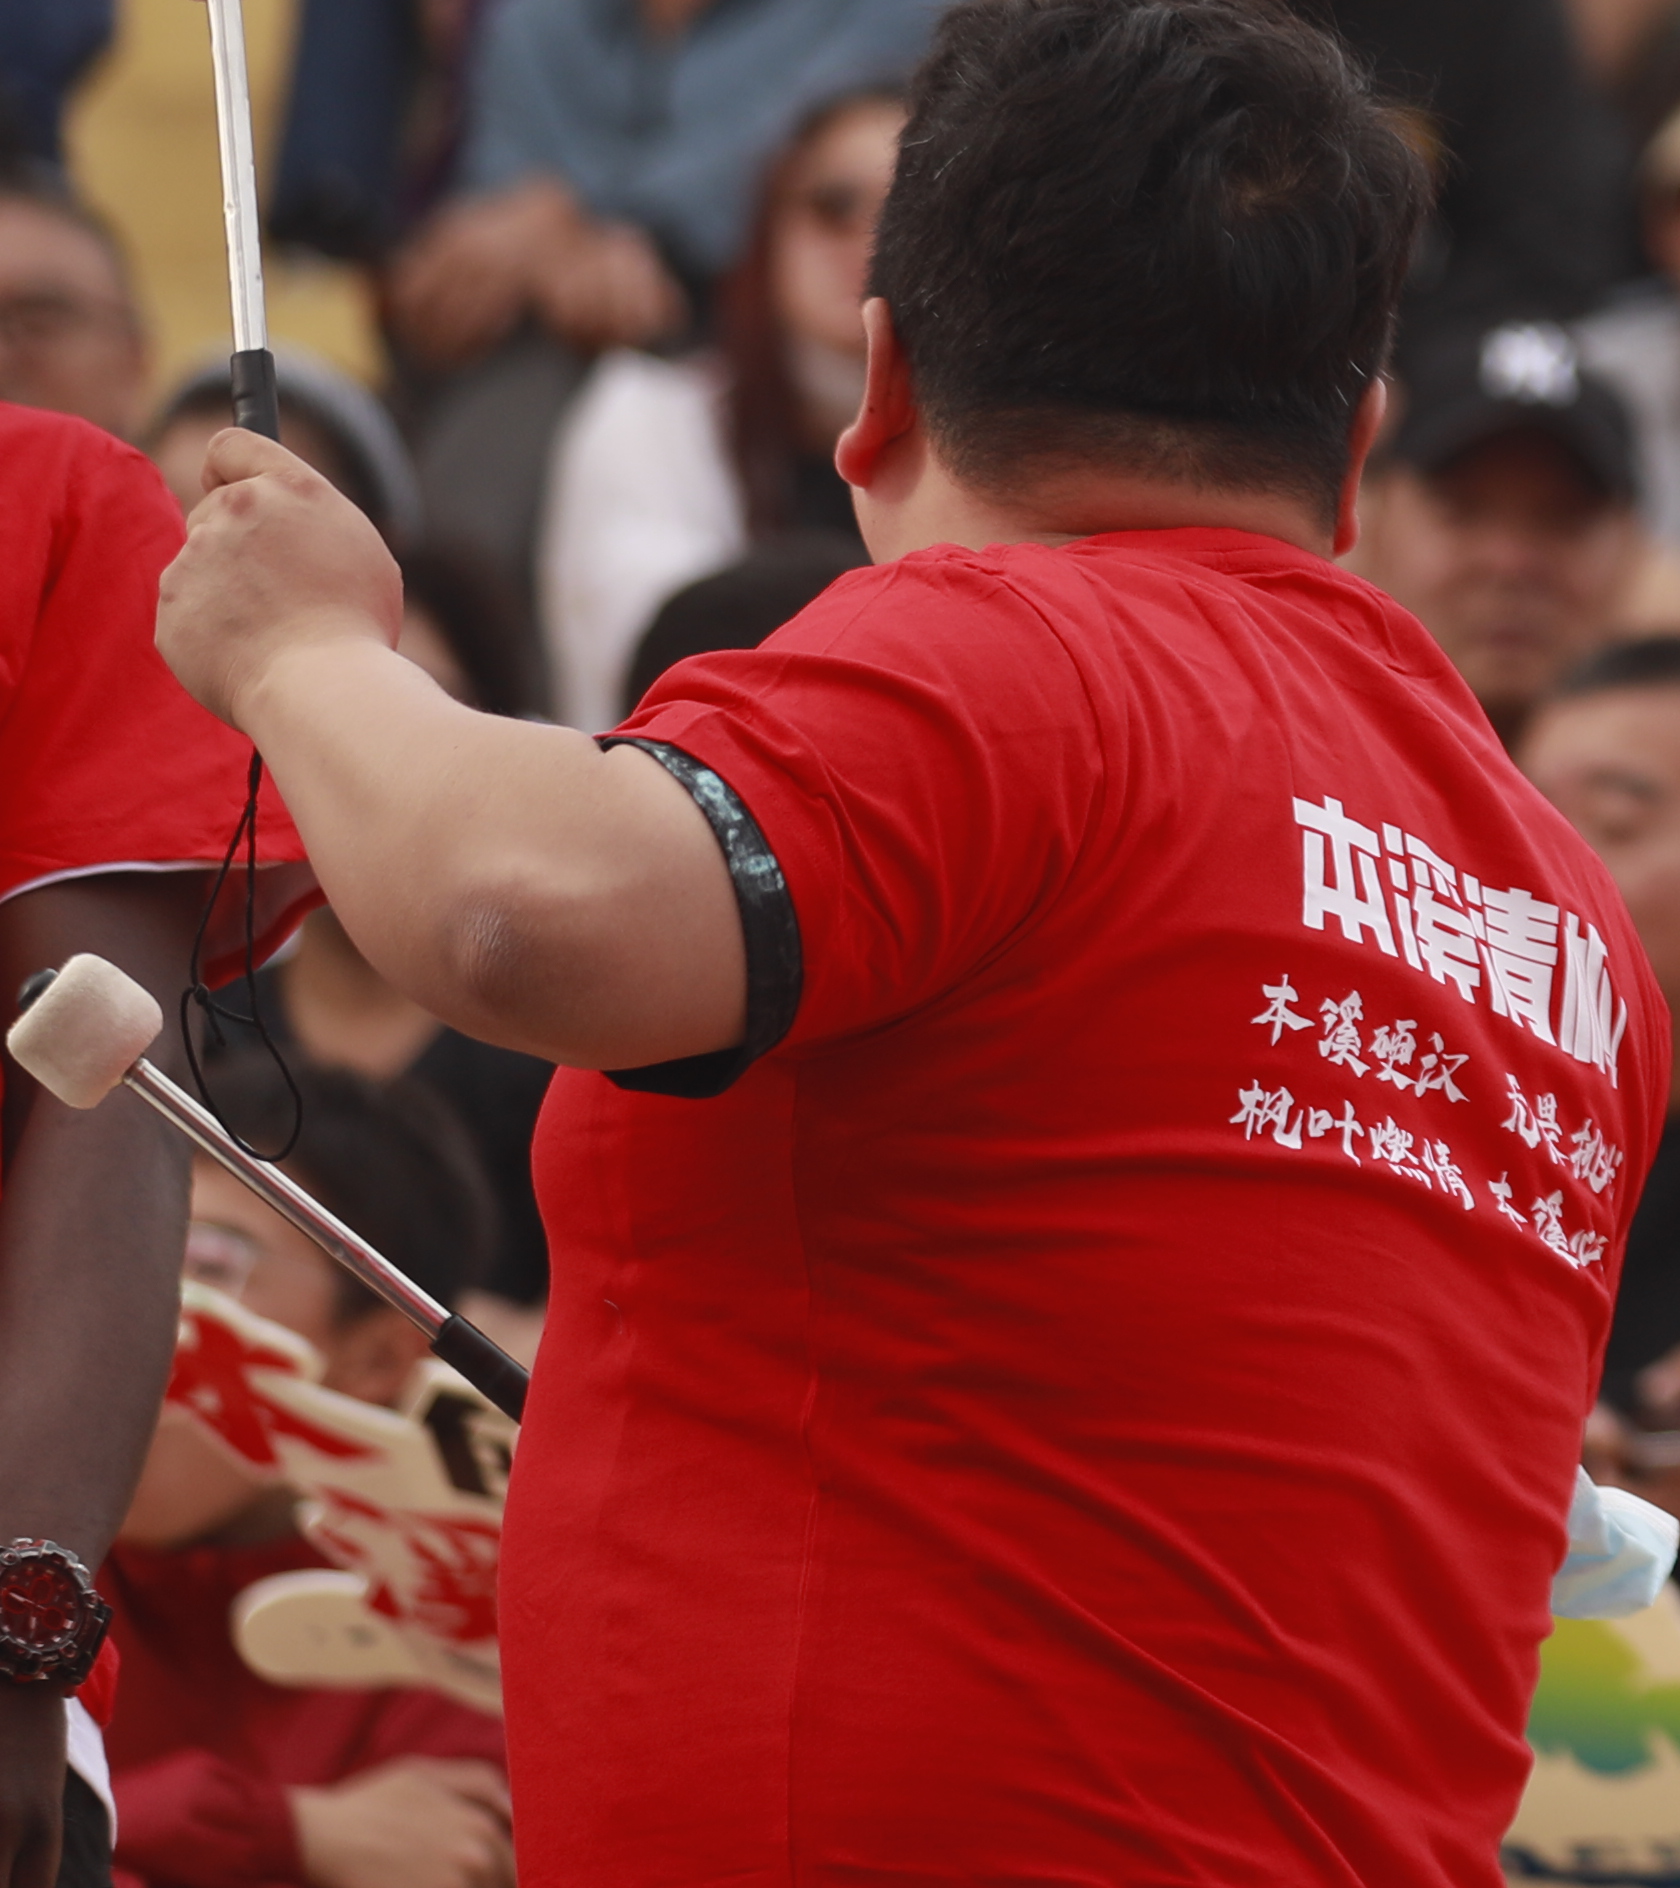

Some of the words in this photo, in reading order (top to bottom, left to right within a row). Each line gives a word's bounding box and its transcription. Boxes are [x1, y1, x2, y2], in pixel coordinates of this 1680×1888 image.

[1229, 1079, 1476, 1211] 枫叶燃情
[1251, 973, 1470, 1103] 本溪硬汉
[1500, 1072, 1624, 1200] 无畏挑
